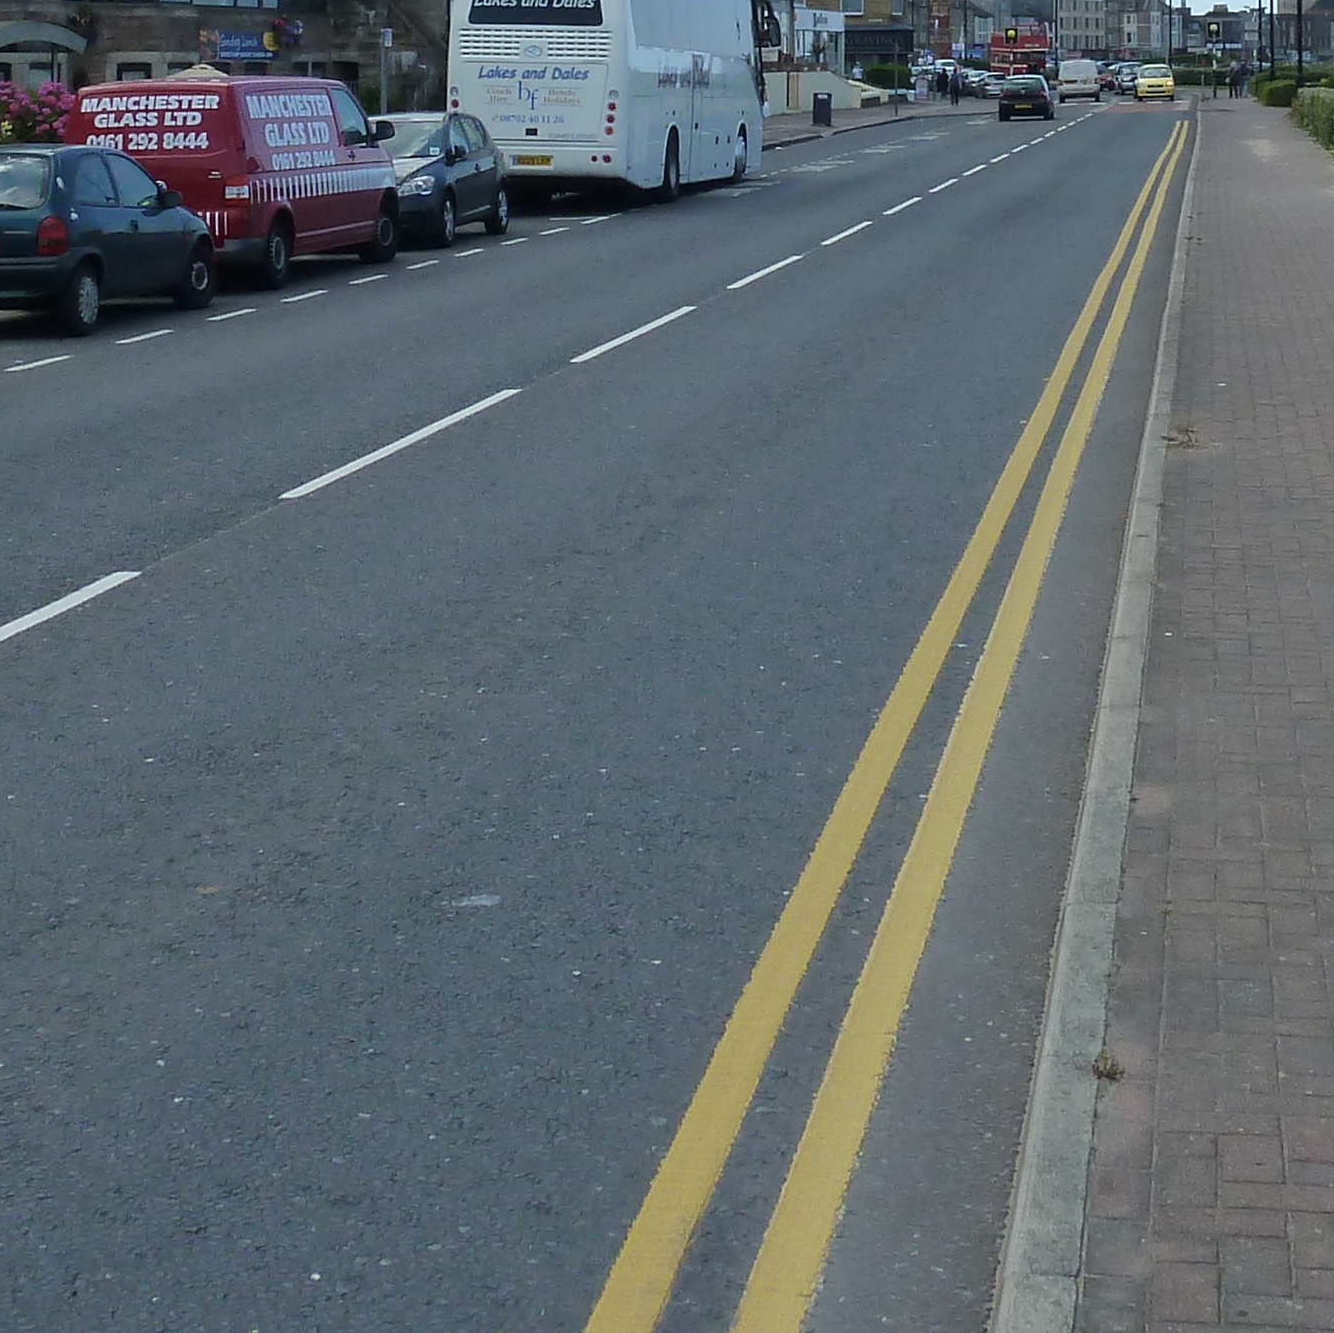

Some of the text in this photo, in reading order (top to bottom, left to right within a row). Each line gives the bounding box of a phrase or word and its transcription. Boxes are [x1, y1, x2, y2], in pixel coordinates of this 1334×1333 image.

[478, 65, 589, 80] Lakes and Dales
[80, 95, 220, 113] MANCHESTER
[246, 94, 333, 119] MANCHESTER
[94, 111, 202, 128] GLASS LTD
[86, 132, 209, 150] 0161 292 8444
[264, 121, 330, 147] GLASS LTD
[272, 150, 336, 171] 0161 292 8444
